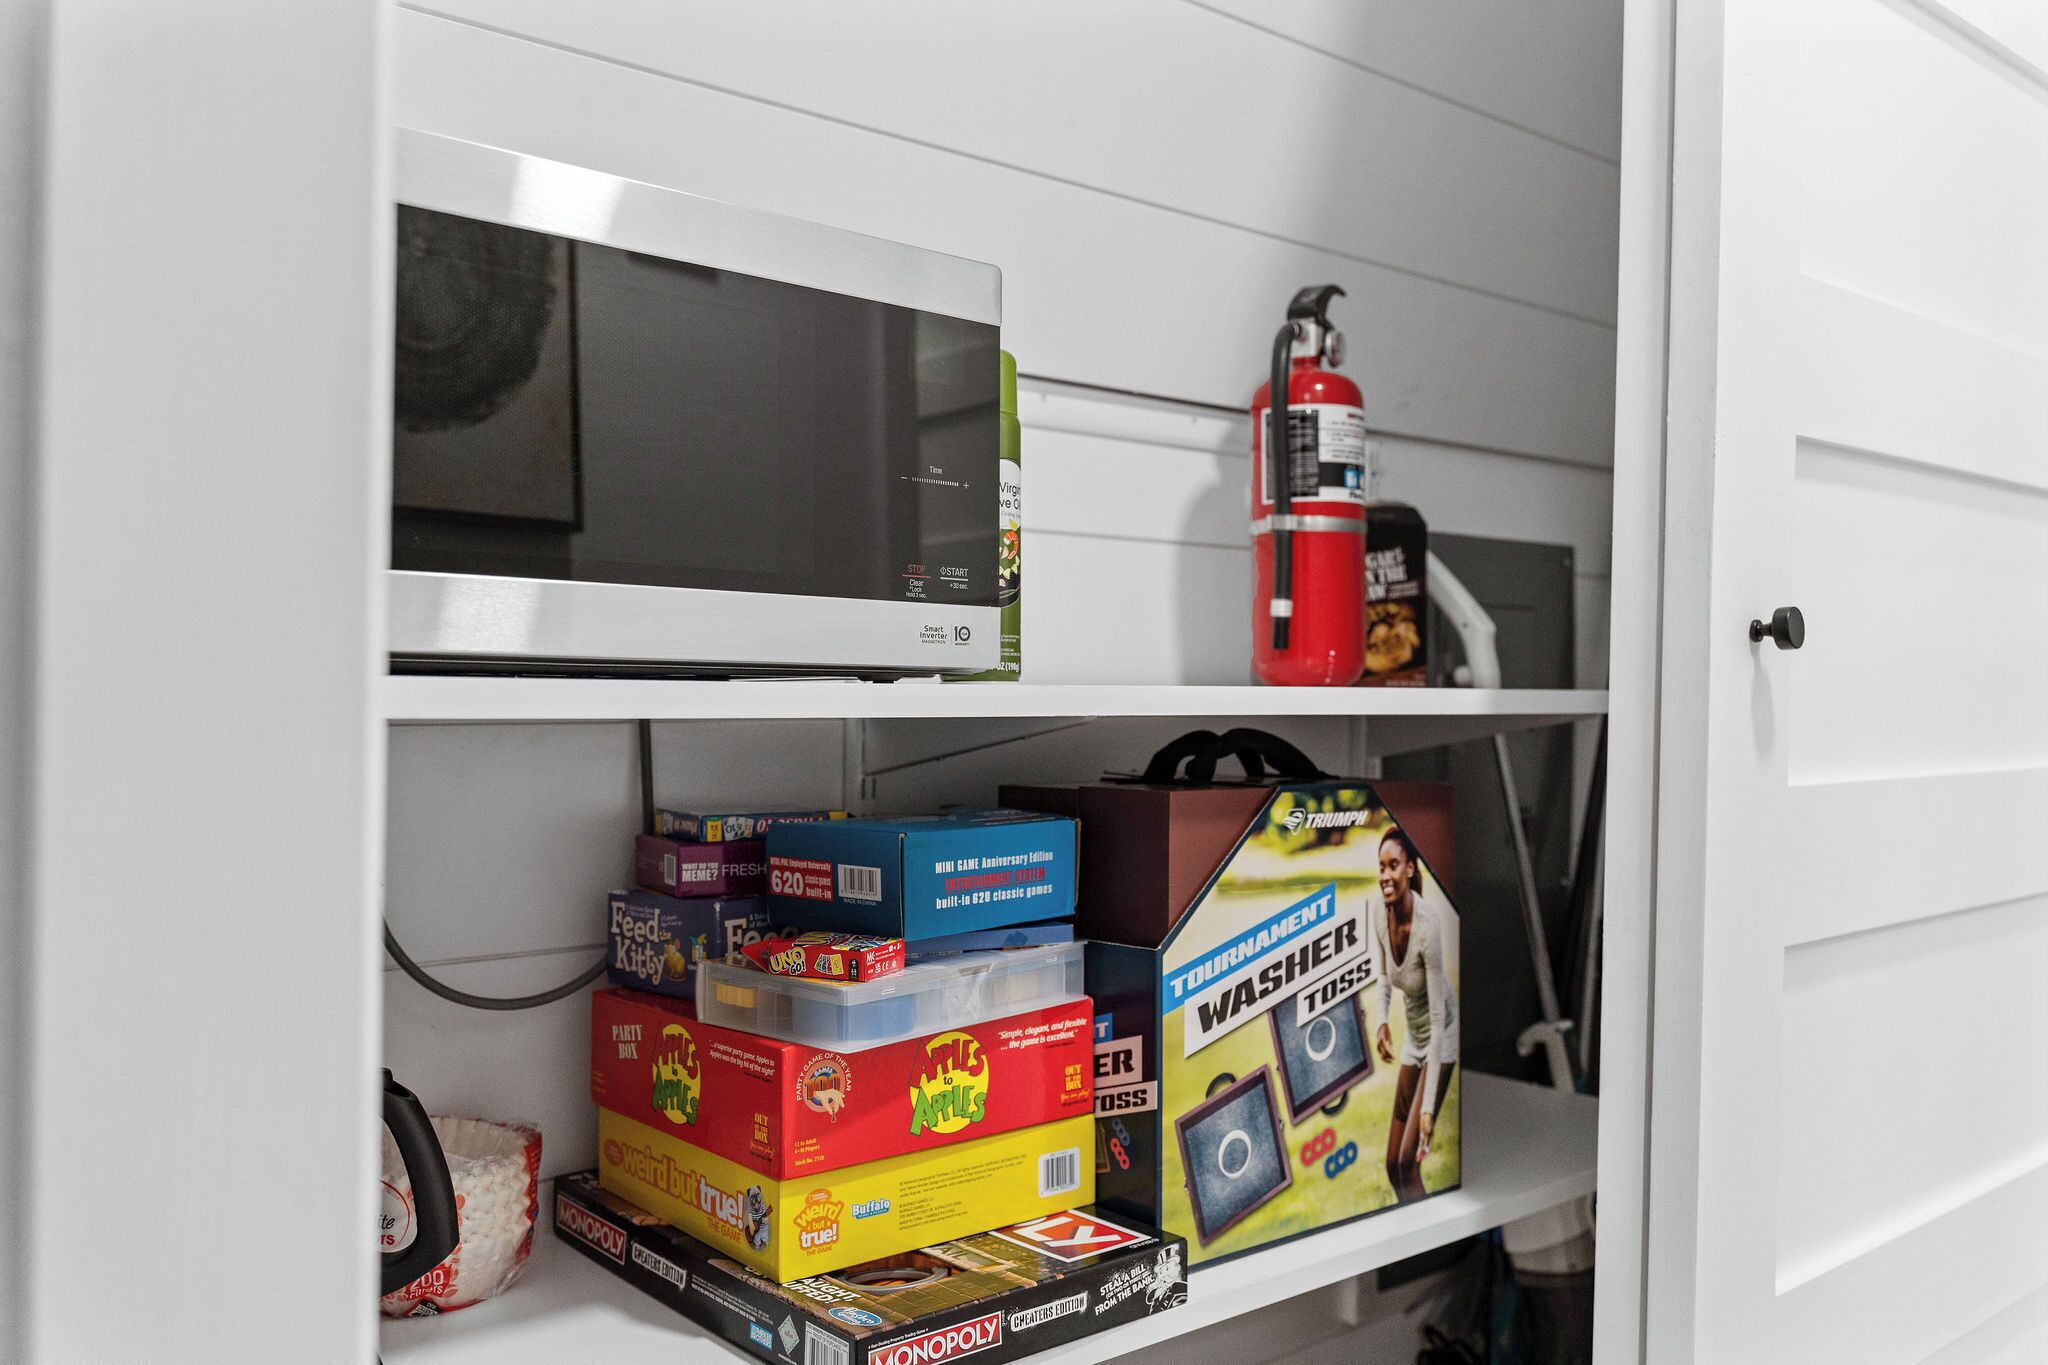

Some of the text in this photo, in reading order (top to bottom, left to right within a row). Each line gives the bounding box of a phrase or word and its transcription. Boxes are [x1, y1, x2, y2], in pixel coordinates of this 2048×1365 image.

[930, 466, 942, 474] Time
[908, 564, 926, 574] STOP
[946, 567, 968, 576] START
[910, 578, 924, 586] Clear
[954, 626, 970, 641] 10
[1305, 810, 1368, 829] TRIUMPH
[722, 864, 767, 876] FRESH
[935, 850, 1053, 874] MINI GAME Anniversary Edition
[682, 870, 718, 882] MEME?
[772, 870, 804, 896] 620
[805, 875, 818, 884] classic
[945, 867, 1045, 891] ENTERTAINMENT SYSTEM
[806, 886, 831, 899] built-in
[936, 884, 1053, 910] built-in 620 classic games
[611, 900, 660, 943] Feed
[1170, 894, 1332, 999] TOURNAMENT
[615, 936, 668, 986] Kitty
[769, 947, 805, 974] UNO
[790, 960, 805, 975] GO!
[1198, 918, 1358, 1034] WASHER
[1304, 958, 1372, 1014] TOSS
[612, 1024, 642, 1041] PARTY
[1025, 1024, 1050, 1036] elegant,
[1051, 1020, 1064, 1030] and
[1064, 1018, 1087, 1030] flexible
[618, 1043, 638, 1060] BOX
[1009, 1040, 1020, 1049] the
[1020, 1038, 1039, 1049] game
[1040, 1035, 1045, 1043] is
[710, 1049, 722, 1059] Apples
[750, 1063, 754, 1071] of
[732, 1048, 743, 1058] party
[756, 1055, 769, 1065] Apples
[910, 1038, 986, 1088] APPLES
[796, 1071, 805, 1101] PARTY
[804, 1054, 823, 1071] GAME
[835, 1055, 848, 1069] THE
[943, 1076, 953, 1086] to
[1065, 1064, 1082, 1076] OUT
[652, 1067, 698, 1126] APPLES
[805, 1074, 840, 1100] 100
[1066, 1080, 1082, 1091] BOX
[910, 1085, 986, 1136] APPLES
[1095, 1089, 1148, 1112] OSS
[755, 1113, 768, 1126] OUT
[755, 1129, 768, 1144] BOX
[621, 1142, 668, 1192] weird
[700, 1176, 744, 1230] true!
[796, 1203, 842, 1226] weird
[852, 1198, 890, 1216] Buffalo
[558, 1203, 624, 1256] MONOPOLY
[708, 1217, 742, 1244] THE GAME
[801, 1223, 837, 1248] true!
[813, 1220, 825, 1230] but
[817, 1245, 832, 1254] GAME
[634, 1246, 685, 1285] CHEATERS EDITION
[1100, 1264, 1146, 1296] STEAL A BILL
[1094, 1274, 1155, 1316] FROM THE BANK.
[1014, 1308, 1053, 1329] CHEATERS
[1055, 1297, 1085, 1317] EDITION
[875, 1318, 998, 1365] MONOPOLY
